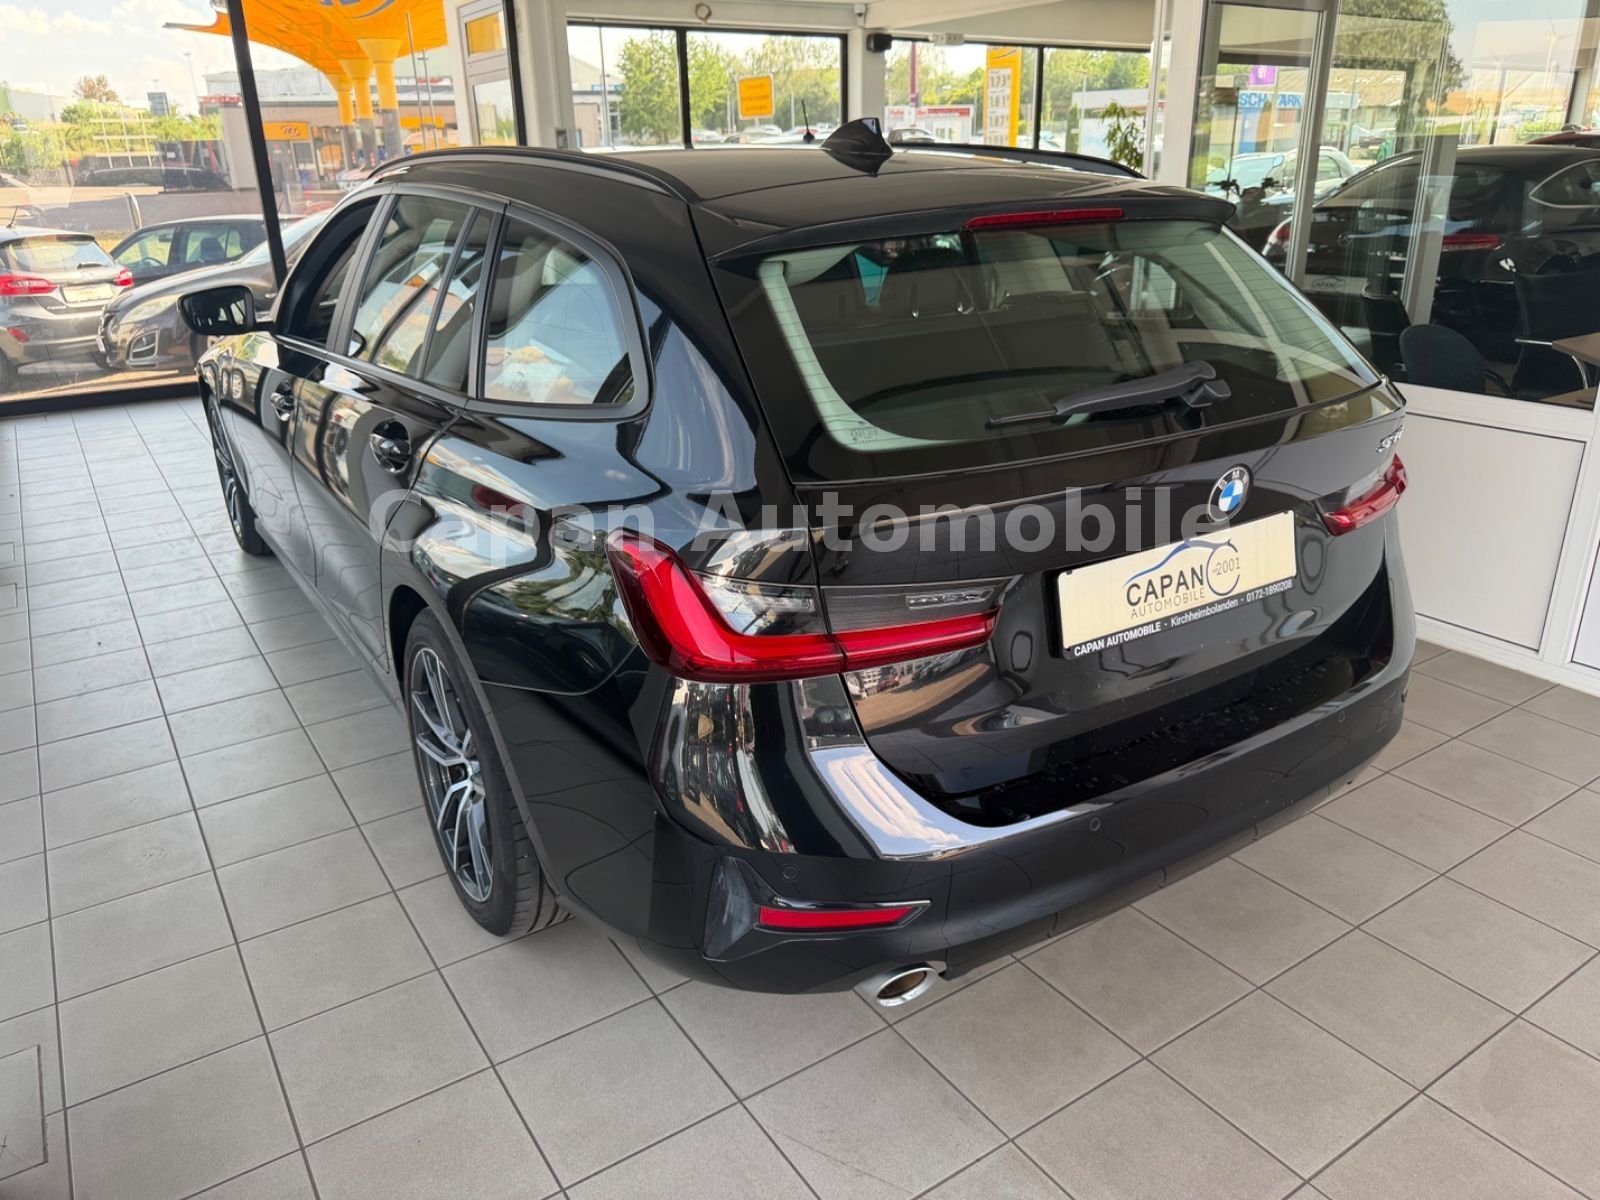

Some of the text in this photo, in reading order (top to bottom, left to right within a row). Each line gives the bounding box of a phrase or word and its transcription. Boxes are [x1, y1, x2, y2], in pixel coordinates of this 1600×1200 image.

[1126, 565, 1204, 607] CAPAN
[1131, 588, 1206, 620] AUTOMOBILE
[1074, 639, 1105, 656] CAPAN
[1106, 621, 1161, 647] AUTOMOBILE
[1170, 599, 1239, 627] Kirchheimbolanden
